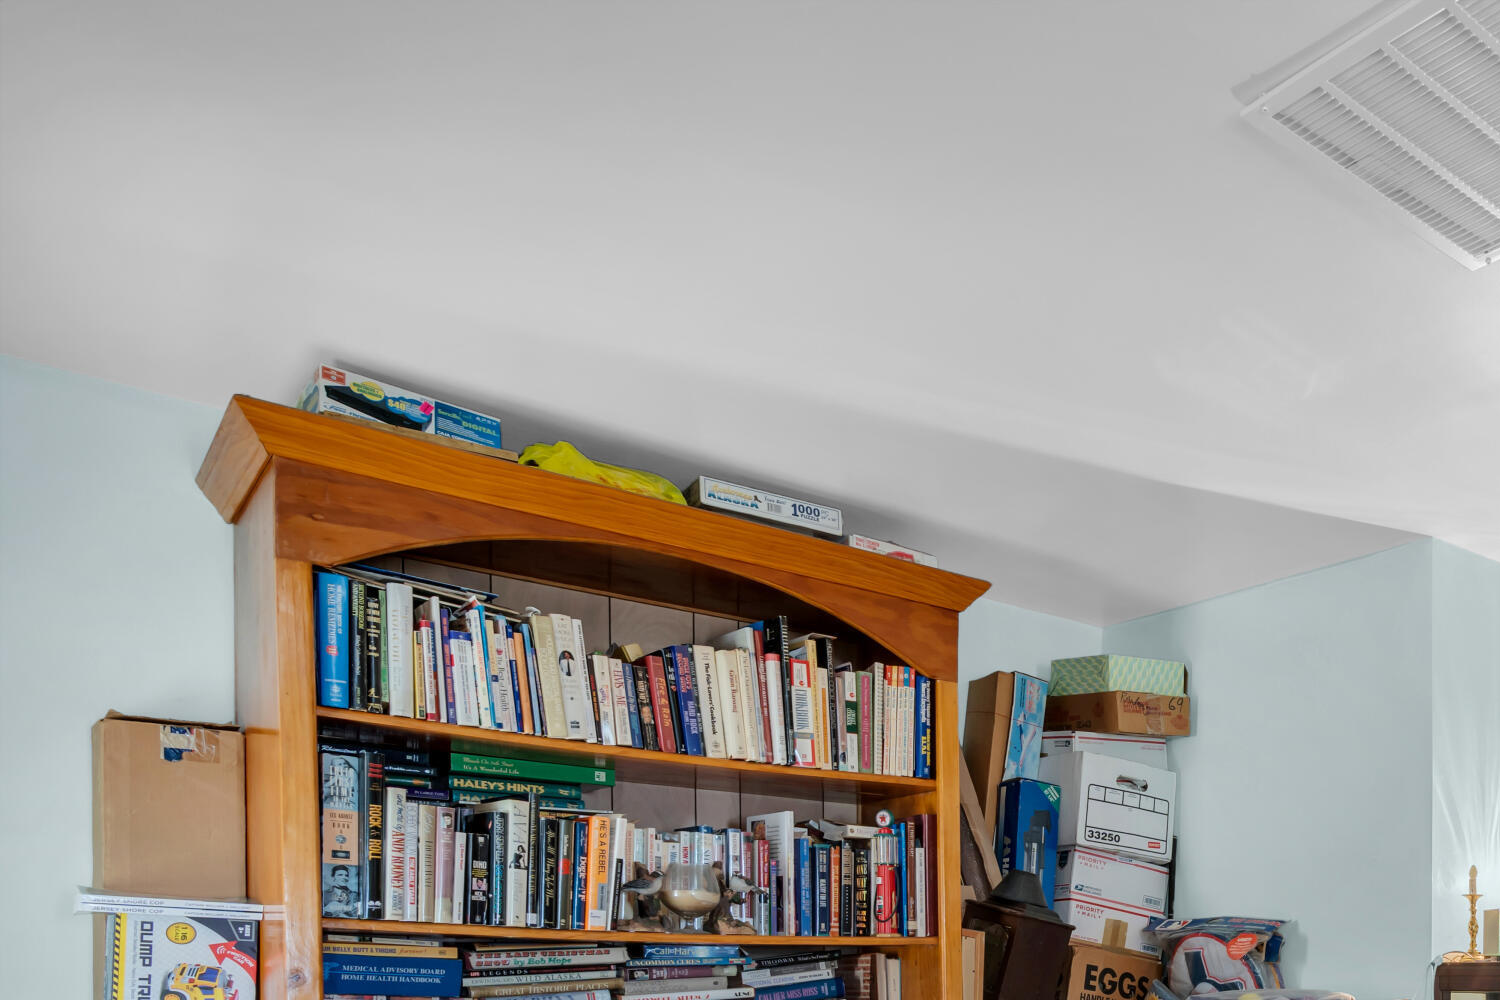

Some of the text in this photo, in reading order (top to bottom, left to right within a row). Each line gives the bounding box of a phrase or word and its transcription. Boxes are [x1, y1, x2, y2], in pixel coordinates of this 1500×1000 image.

[461, 420, 498, 437] DIGITAL
[791, 503, 821, 518] 1000
[800, 512, 820, 523] PUZZLE
[327, 584, 337, 644] HOME REMEDIES
[498, 668, 506, 680] Best
[501, 689, 510, 712] Health
[1168, 696, 1184, 713] 69
[795, 689, 810, 730] COOKBOOK
[662, 708, 671, 727] Rain
[687, 701, 698, 734] HARD ROCK
[710, 707, 718, 735] Cookbook
[453, 778, 545, 795] HALEY'S HINTS
[369, 804, 382, 860] ROCK ROLL
[599, 820, 607, 838] HE'S
[1087, 829, 1121, 843] 33250
[392, 830, 404, 855] ANDY
[472, 860, 487, 869] DINO
[598, 850, 607, 875] REBEL
[1078, 854, 1107, 866] PRIORITY
[1084, 861, 1101, 869] MAIL
[391, 856, 404, 889] ROONEY
[1076, 903, 1105, 915] PRIORITY
[1081, 911, 1098, 919] MAIL
[138, 920, 154, 967] DUMP
[227, 949, 255, 968] FRICTION
[476, 949, 611, 959] THE LAST CHRISTMAS
[476, 957, 572, 967] SHOW by Bob Hope
[629, 959, 675, 967] UNCOMMON
[342, 965, 446, 976] MEDICAL ADVISORY BOARD
[515, 975, 543, 983] WILD
[545, 973, 582, 981] ALASKA
[399, 976, 441, 984] HANDBOOK
[495, 982, 609, 996] GREAT HISTORIC PLACES
[774, 991, 786, 1000] HER
[787, 989, 801, 999] MISS
[802, 987, 819, 997] ROSS
